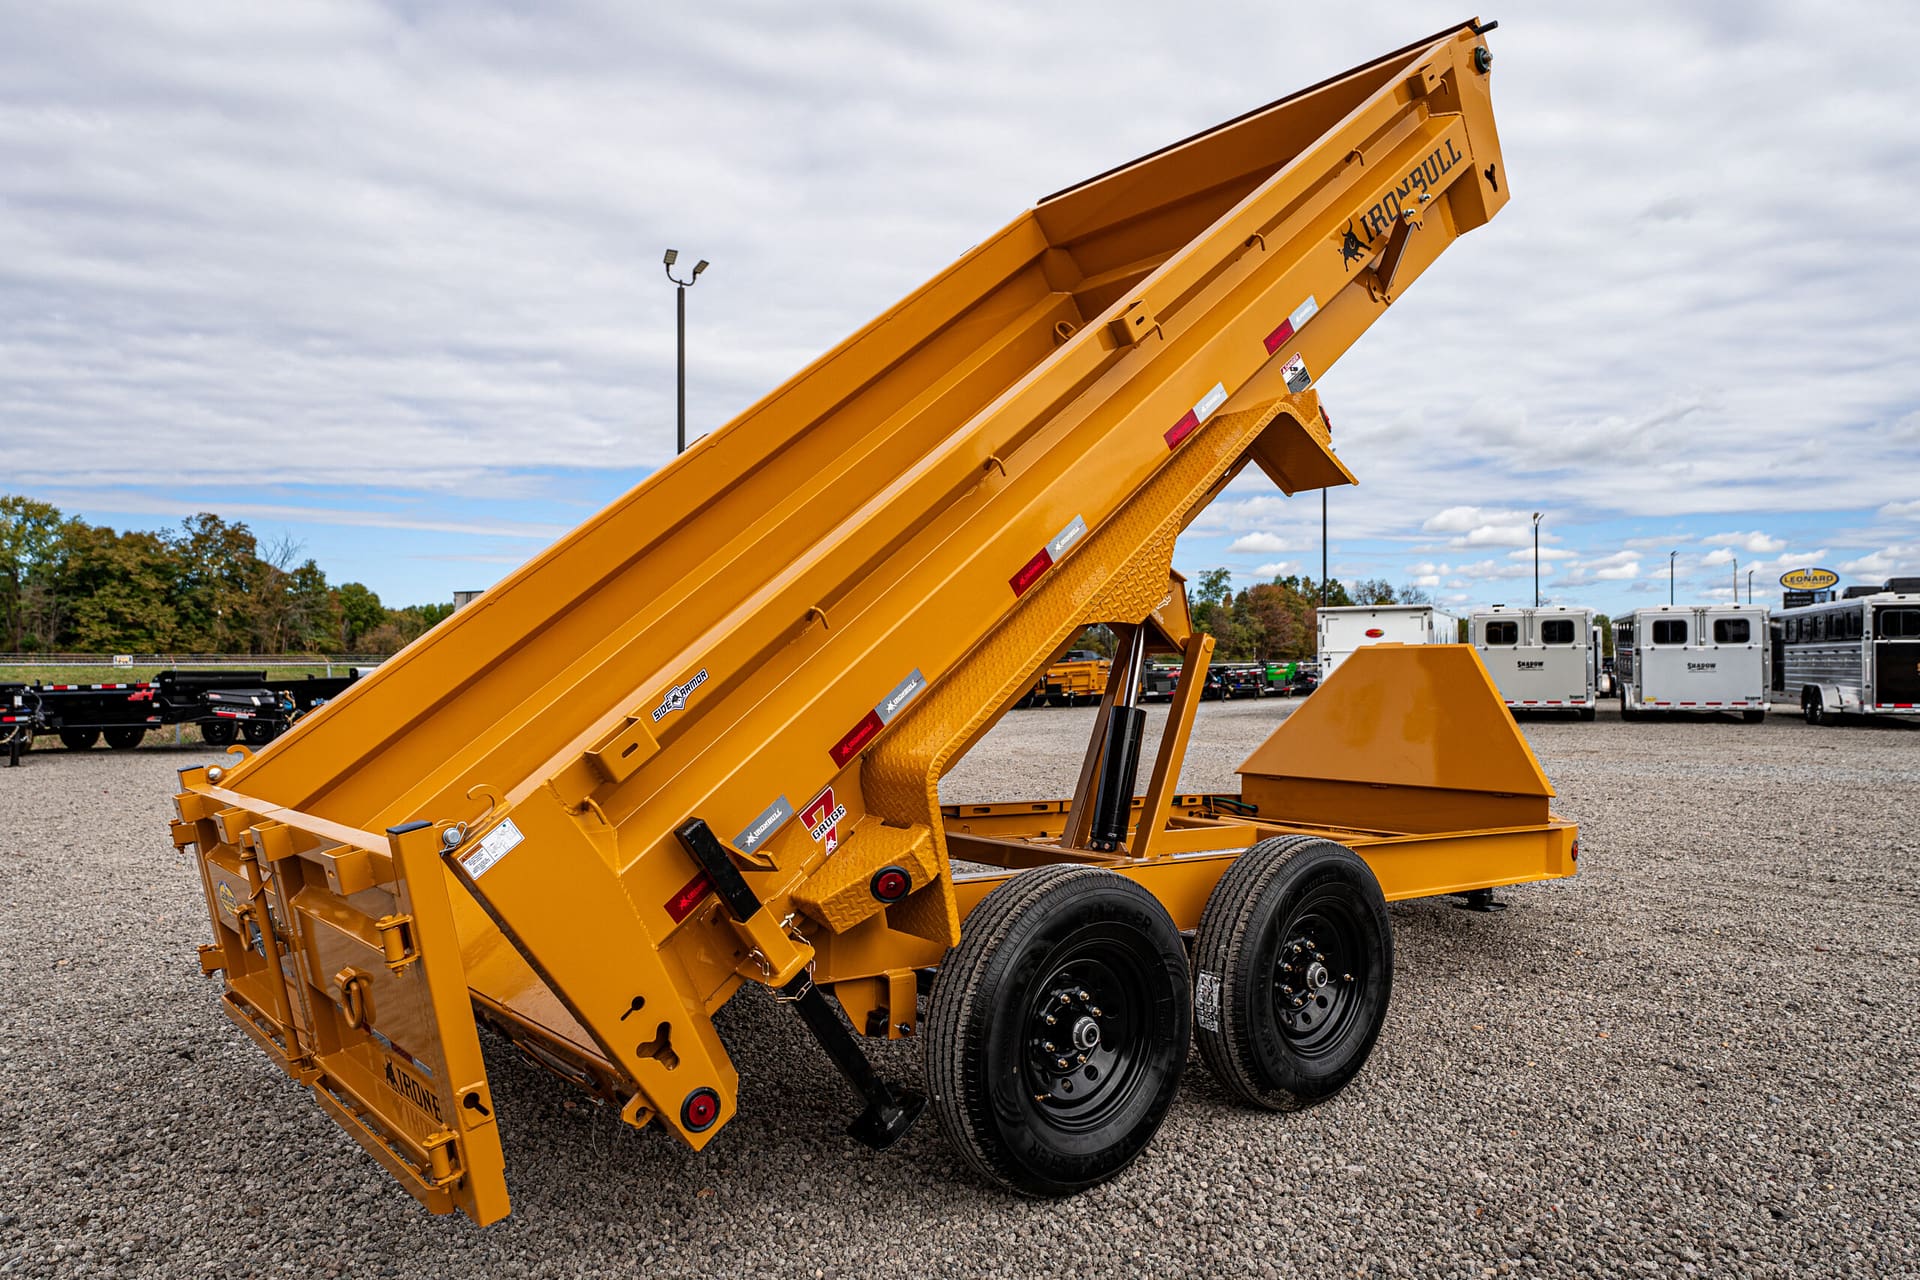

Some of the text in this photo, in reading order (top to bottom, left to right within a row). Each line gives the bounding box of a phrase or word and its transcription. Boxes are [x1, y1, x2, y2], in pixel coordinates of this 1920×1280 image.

[1784, 575, 1834, 584] LEONARD
[653, 670, 707, 720] SIDE ARMOR
[799, 787, 837, 855] 7
[812, 805, 845, 839] GAUGE
